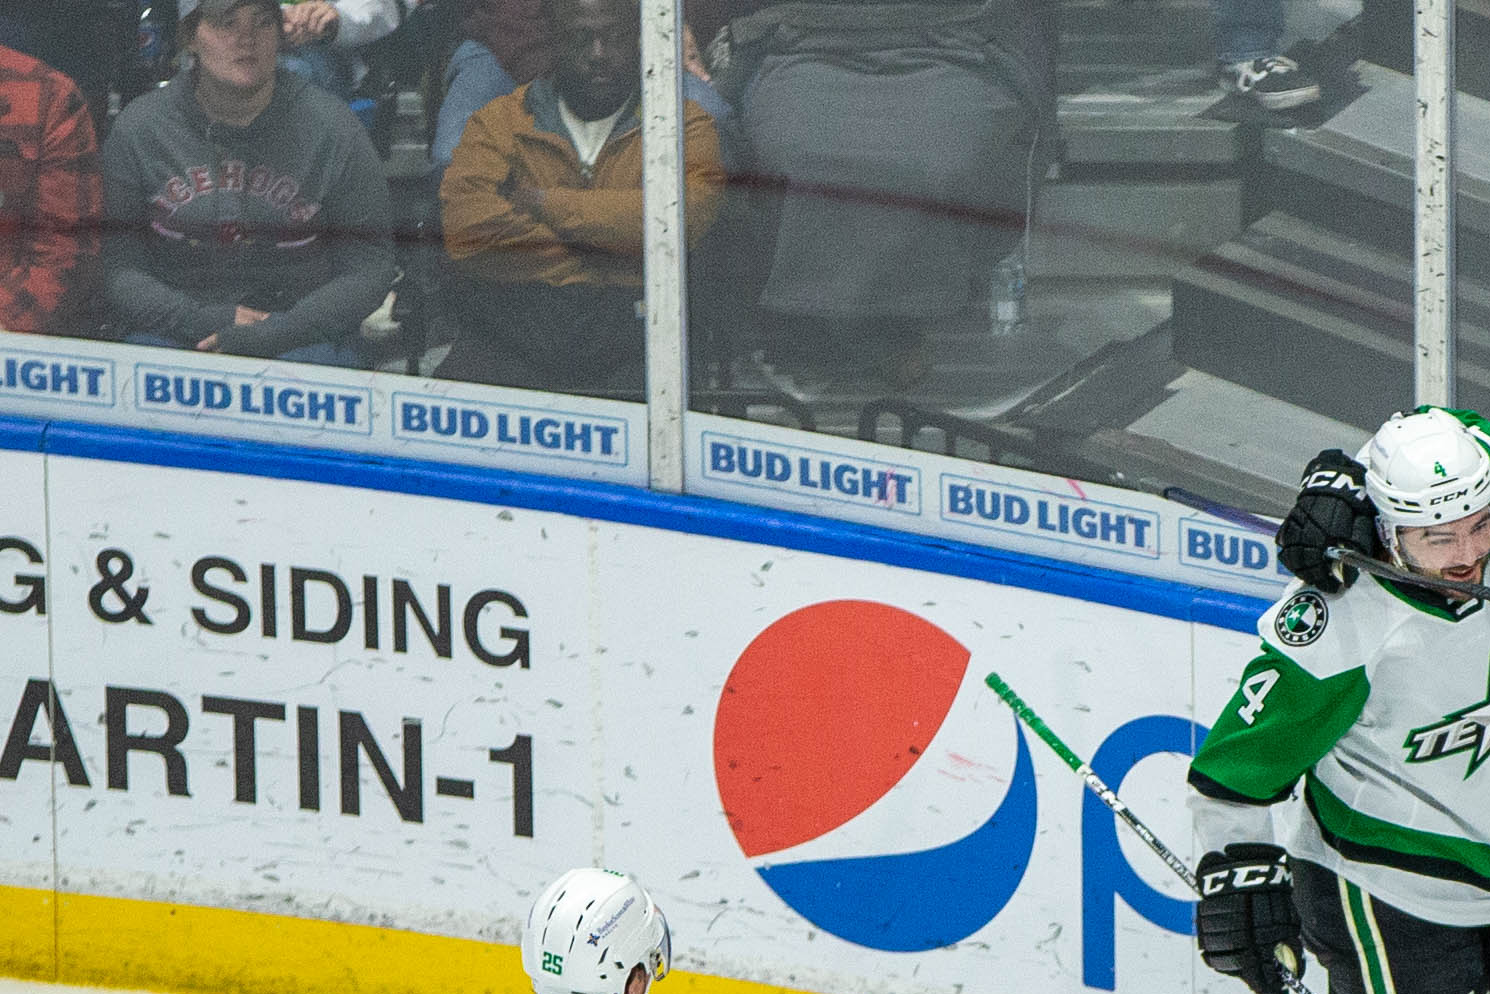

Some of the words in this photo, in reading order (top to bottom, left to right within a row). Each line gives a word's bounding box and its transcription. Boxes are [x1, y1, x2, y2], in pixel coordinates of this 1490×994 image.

[0, 357, 104, 397] IGHT
[144, 372, 232, 410] BUD
[240, 383, 363, 425] LIGHT
[401, 402, 489, 439] BUD
[497, 412, 619, 455] LIGHT
[709, 441, 792, 482] BUD
[799, 457, 912, 504] LIGHT
[1433, 461, 1448, 477] 4
[948, 484, 1030, 525] BUD
[1037, 500, 1151, 549] LIGHT
[1429, 488, 1469, 506] CCM
[1186, 528, 1270, 570] BUD
[88, 547, 154, 626] &
[190, 555, 532, 670] SIDING
[1238, 667, 1280, 725] 4
[0, 677, 534, 839] ARTIN-1
[1202, 851, 1294, 898] CCM
[542, 950, 564, 976] 25
